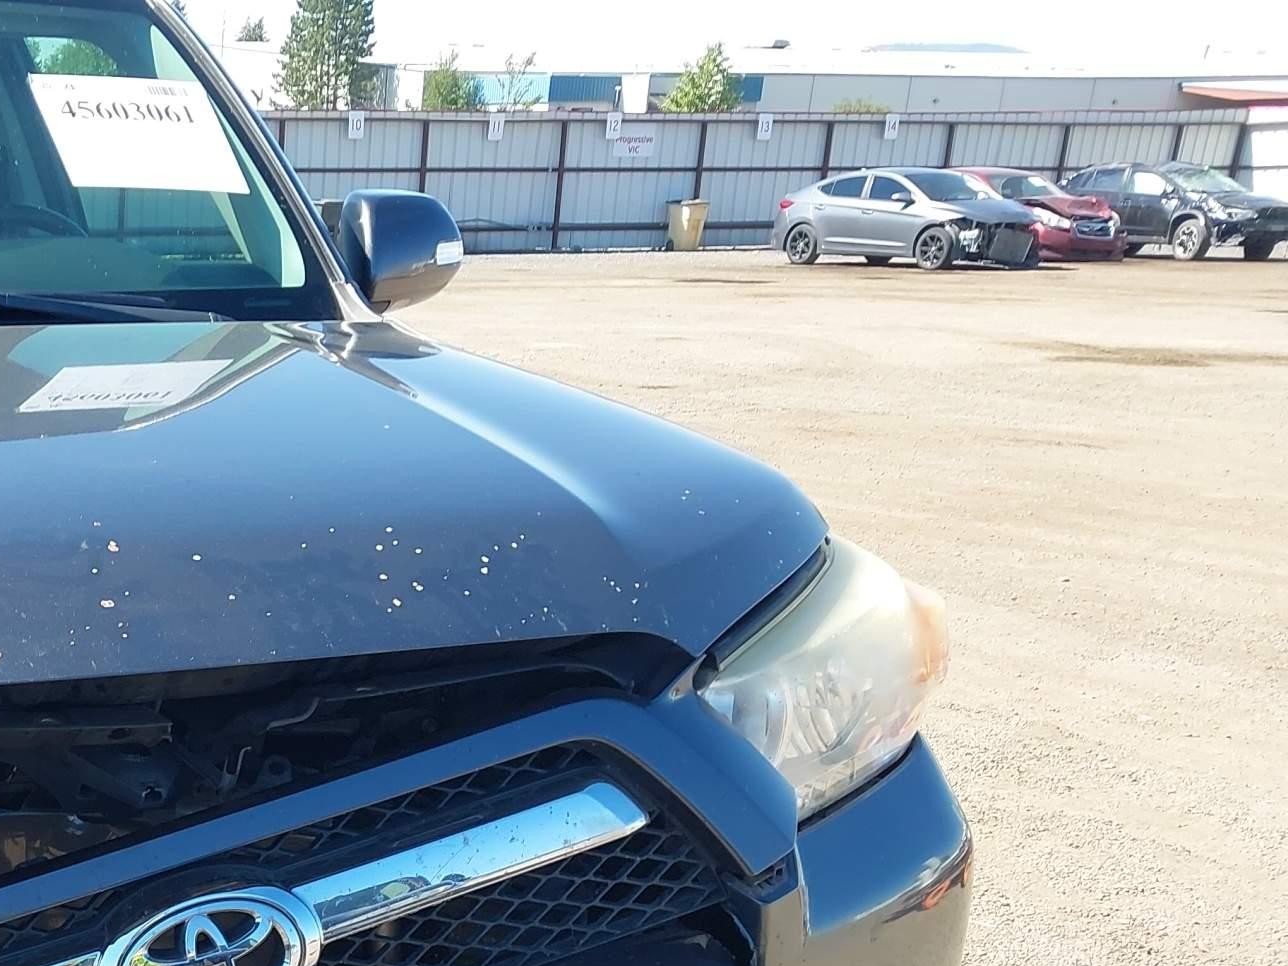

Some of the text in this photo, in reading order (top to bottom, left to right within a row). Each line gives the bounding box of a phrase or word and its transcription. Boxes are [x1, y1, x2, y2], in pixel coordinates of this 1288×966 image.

[61, 100, 194, 123] 45603061
[351, 119, 361, 131] 10
[492, 121, 501, 133] 11
[609, 120, 619, 131] 12
[760, 121, 770, 133] 13
[887, 121, 897, 132] 14
